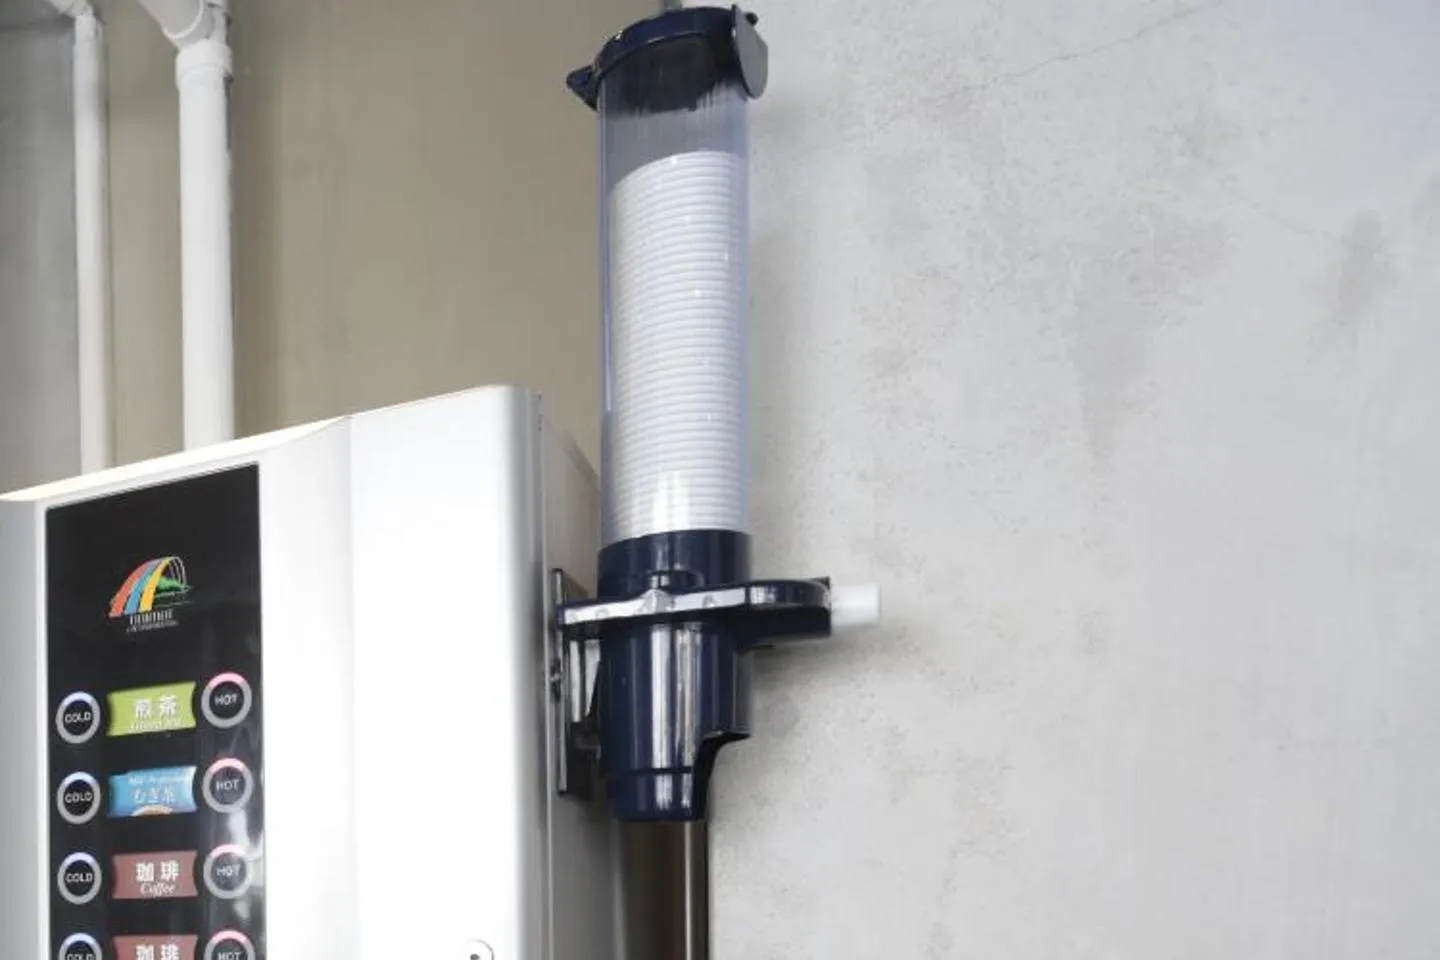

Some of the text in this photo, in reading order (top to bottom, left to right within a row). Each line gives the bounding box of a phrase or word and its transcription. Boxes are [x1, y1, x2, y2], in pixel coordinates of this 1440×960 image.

[214, 692, 239, 706] HOT
[64, 711, 92, 724] COLD
[215, 778, 241, 792] HOT
[64, 791, 93, 804] COLD
[135, 860, 180, 883] 珈琲
[216, 864, 241, 877] HOT
[66, 872, 93, 884] COLD
[140, 882, 176, 898] Coffee
